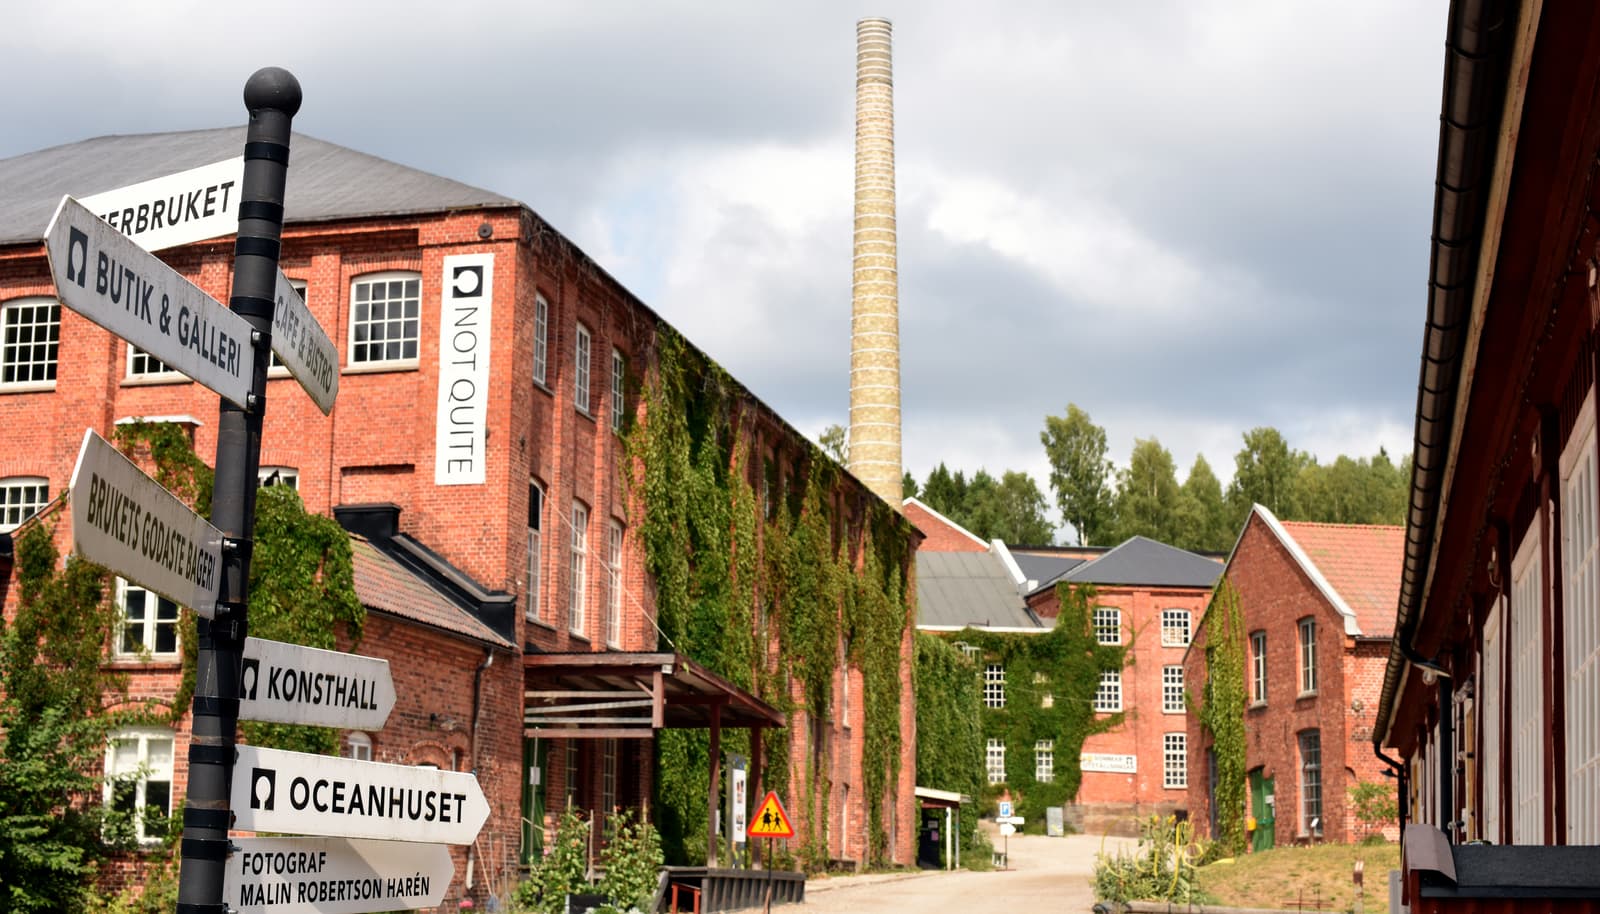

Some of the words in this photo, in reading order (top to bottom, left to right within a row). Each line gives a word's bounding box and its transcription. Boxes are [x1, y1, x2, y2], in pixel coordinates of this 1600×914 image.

[96, 251, 154, 325] BUTIK
[159, 294, 172, 336] &
[178, 306, 241, 378] GALLERI
[452, 307, 479, 371] NOT
[298, 327, 306, 361] &
[305, 337, 333, 394] BISTRO
[447, 378, 476, 474] QUITE
[87, 472, 142, 550] BRUKETS
[142, 511, 186, 577] GODASTE
[185, 543, 216, 593] BAGERI
[267, 666, 378, 711] KONSTHALL
[289, 776, 467, 823] OCEANHUSET
[239, 882, 292, 907] MALIN
[297, 878, 382, 904] ROBERTSON
[386, 871, 430, 898] HARÉN
[241, 851, 327, 876] FOTOGRAF
